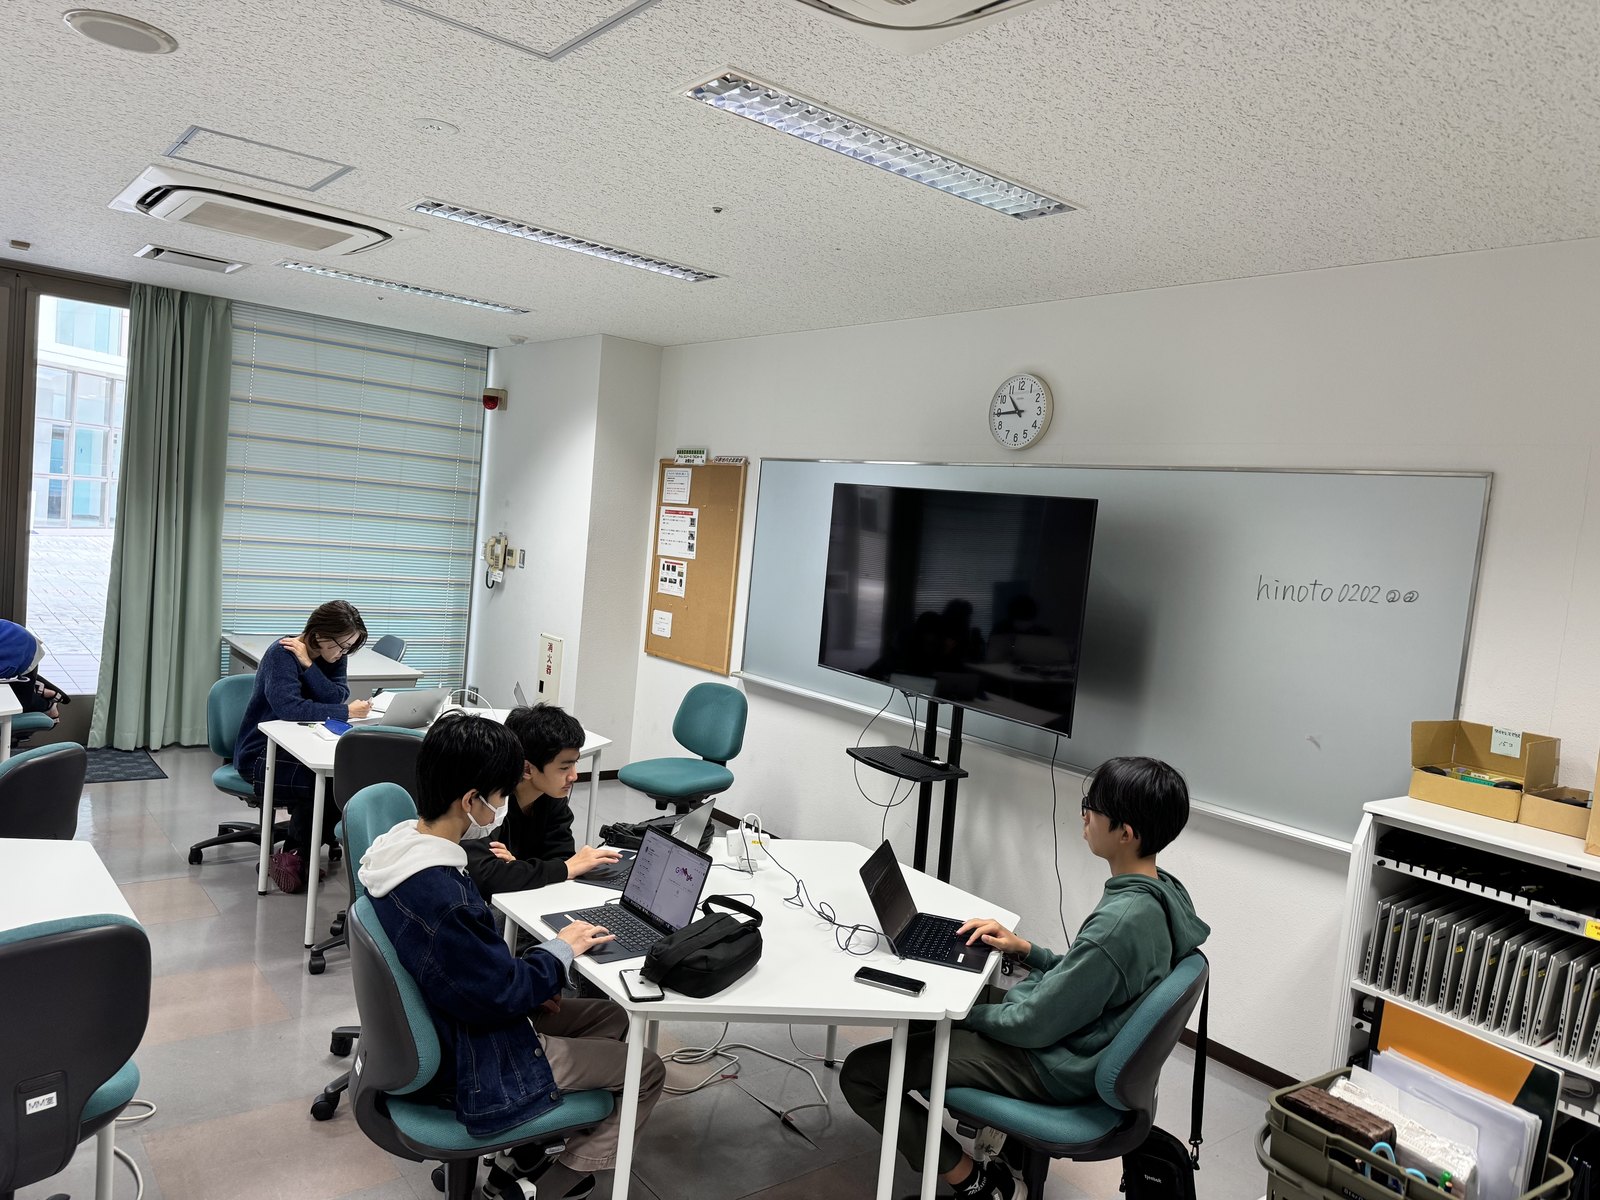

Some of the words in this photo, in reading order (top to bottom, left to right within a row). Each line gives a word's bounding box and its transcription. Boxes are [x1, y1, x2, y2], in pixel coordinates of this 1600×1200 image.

[1009, 385, 1015, 394] 11
[1018, 380, 1025, 391] 12
[1000, 395, 1007, 404] 10
[1035, 393, 1041, 402] 2
[1036, 406, 1042, 416] 3
[997, 421, 1003, 430] 8
[1031, 420, 1037, 429] 4
[1005, 430, 1011, 439] 7
[1013, 433, 1019, 442] 6
[1022, 430, 1028, 438] 5
[545, 642, 553, 675] 消火器
